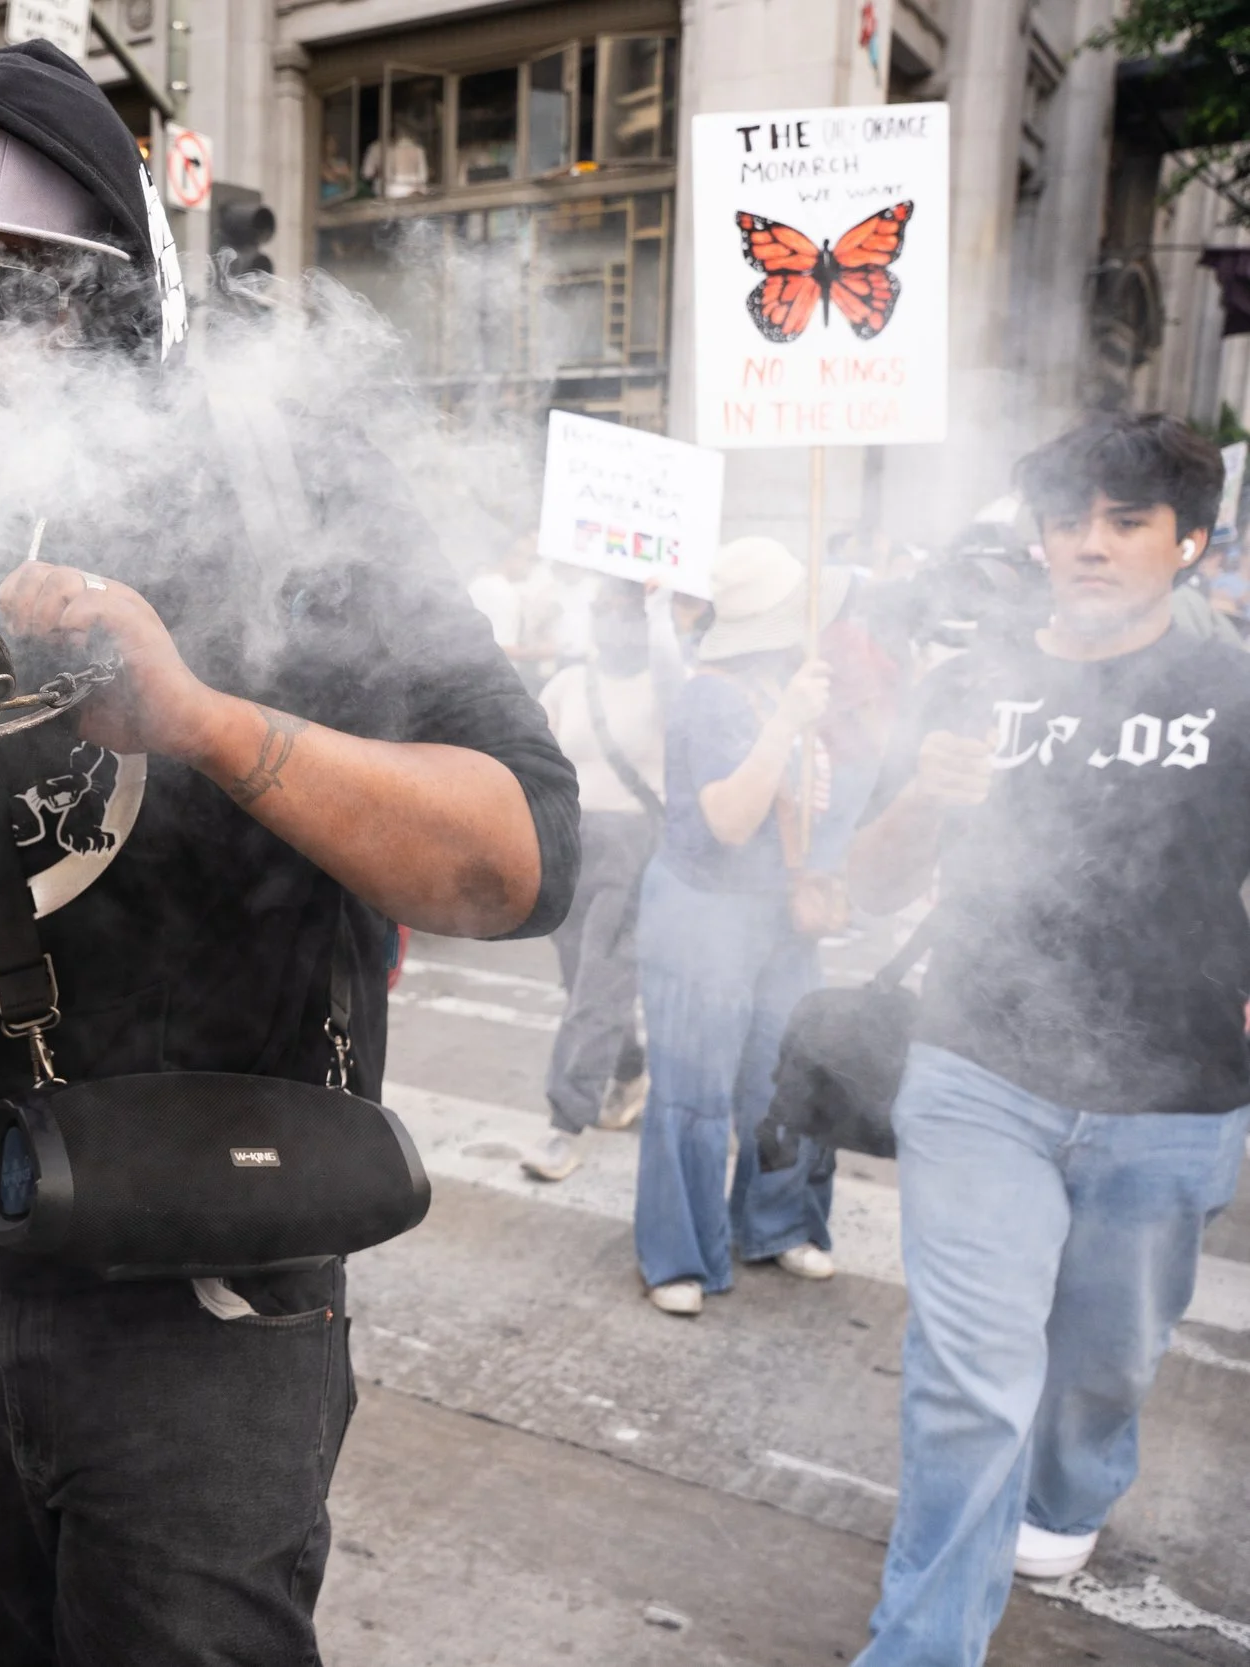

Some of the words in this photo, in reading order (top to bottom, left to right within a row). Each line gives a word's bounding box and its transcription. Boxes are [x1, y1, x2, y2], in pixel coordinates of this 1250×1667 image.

[736, 121, 811, 153] THE
[862, 116, 929, 142] ORANGE
[740, 155, 860, 184] MONARCH
[798, 188, 831, 202] WE
[742, 356, 785, 389] NO
[818, 356, 906, 388] KINGS
[723, 400, 756, 435] IN
[770, 400, 835, 434] THE
[845, 398, 901, 432] USA
[234, 1152, 277, 1164] W-KING
